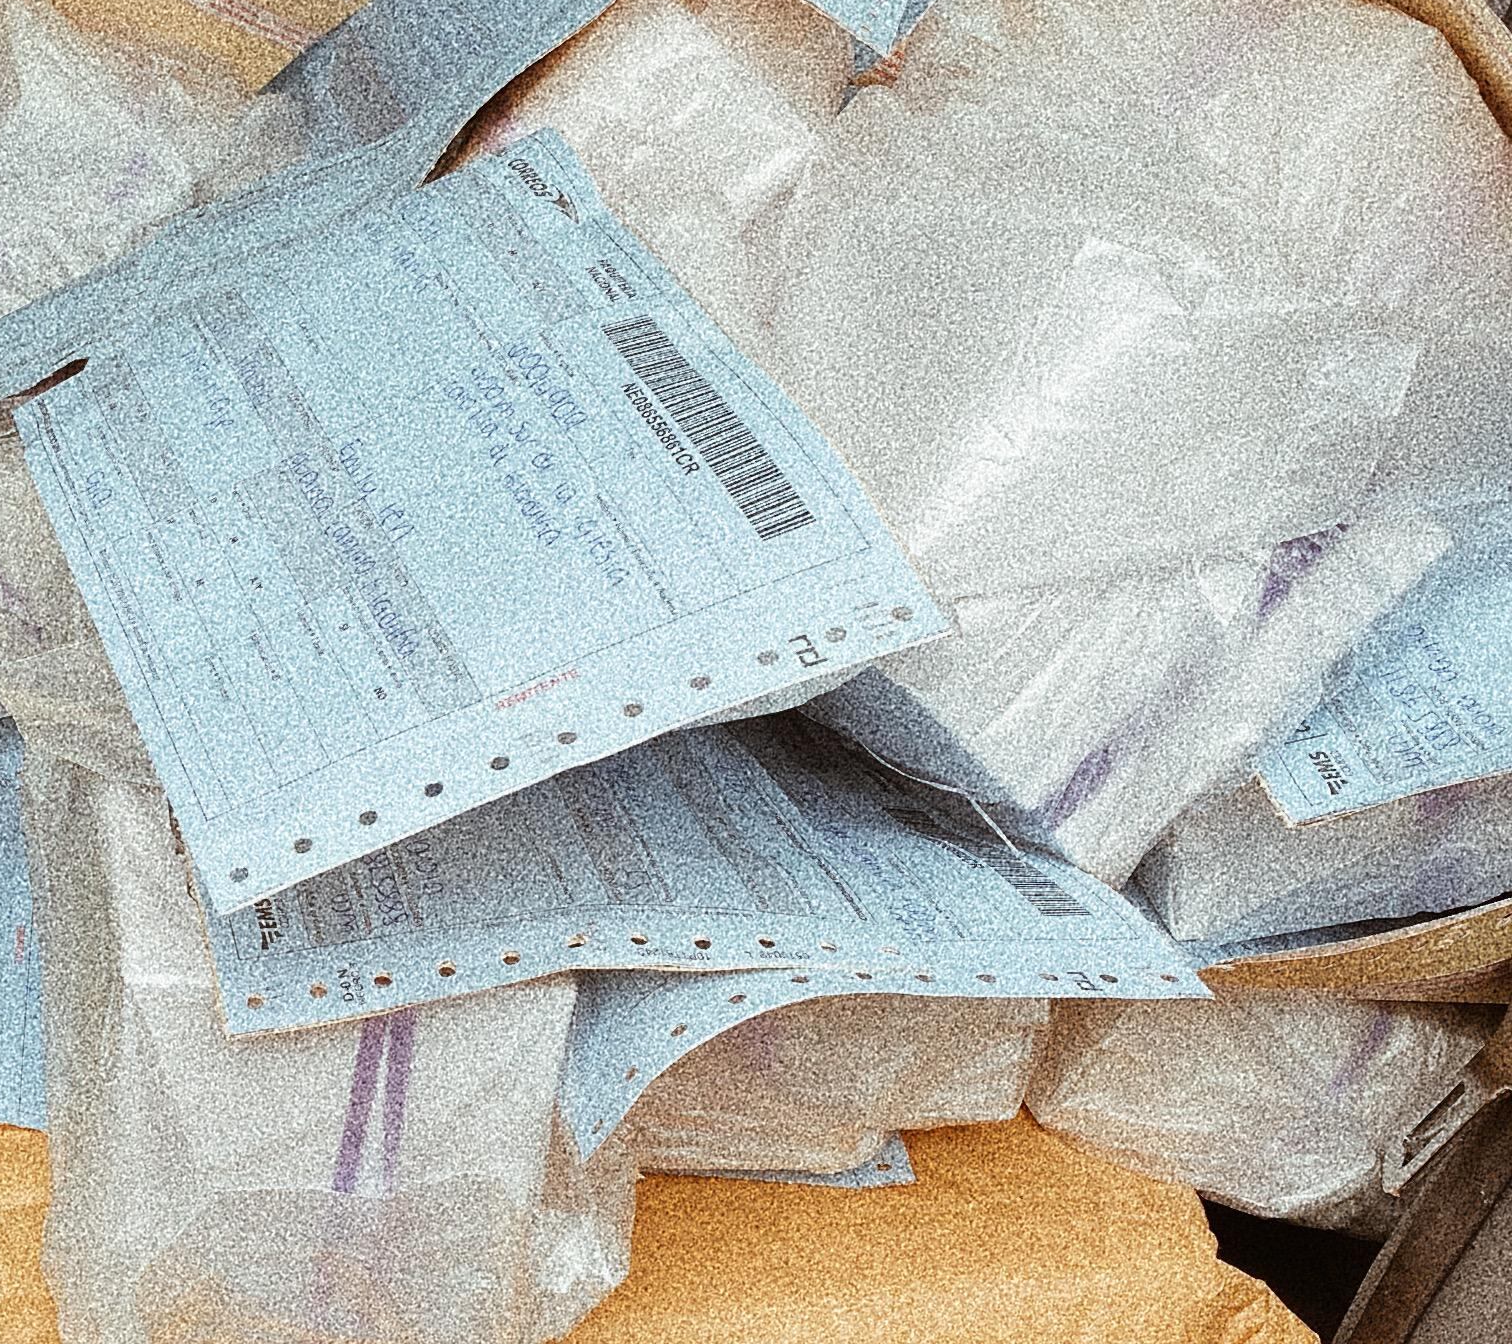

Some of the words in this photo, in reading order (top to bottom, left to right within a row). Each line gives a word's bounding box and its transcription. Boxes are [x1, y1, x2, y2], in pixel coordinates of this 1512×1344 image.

[507, 158, 553, 199] CORREOS
[621, 382, 701, 476] NE086556861CR
[1309, 749, 1342, 784] EMS
[254, 896, 277, 931] EMS
